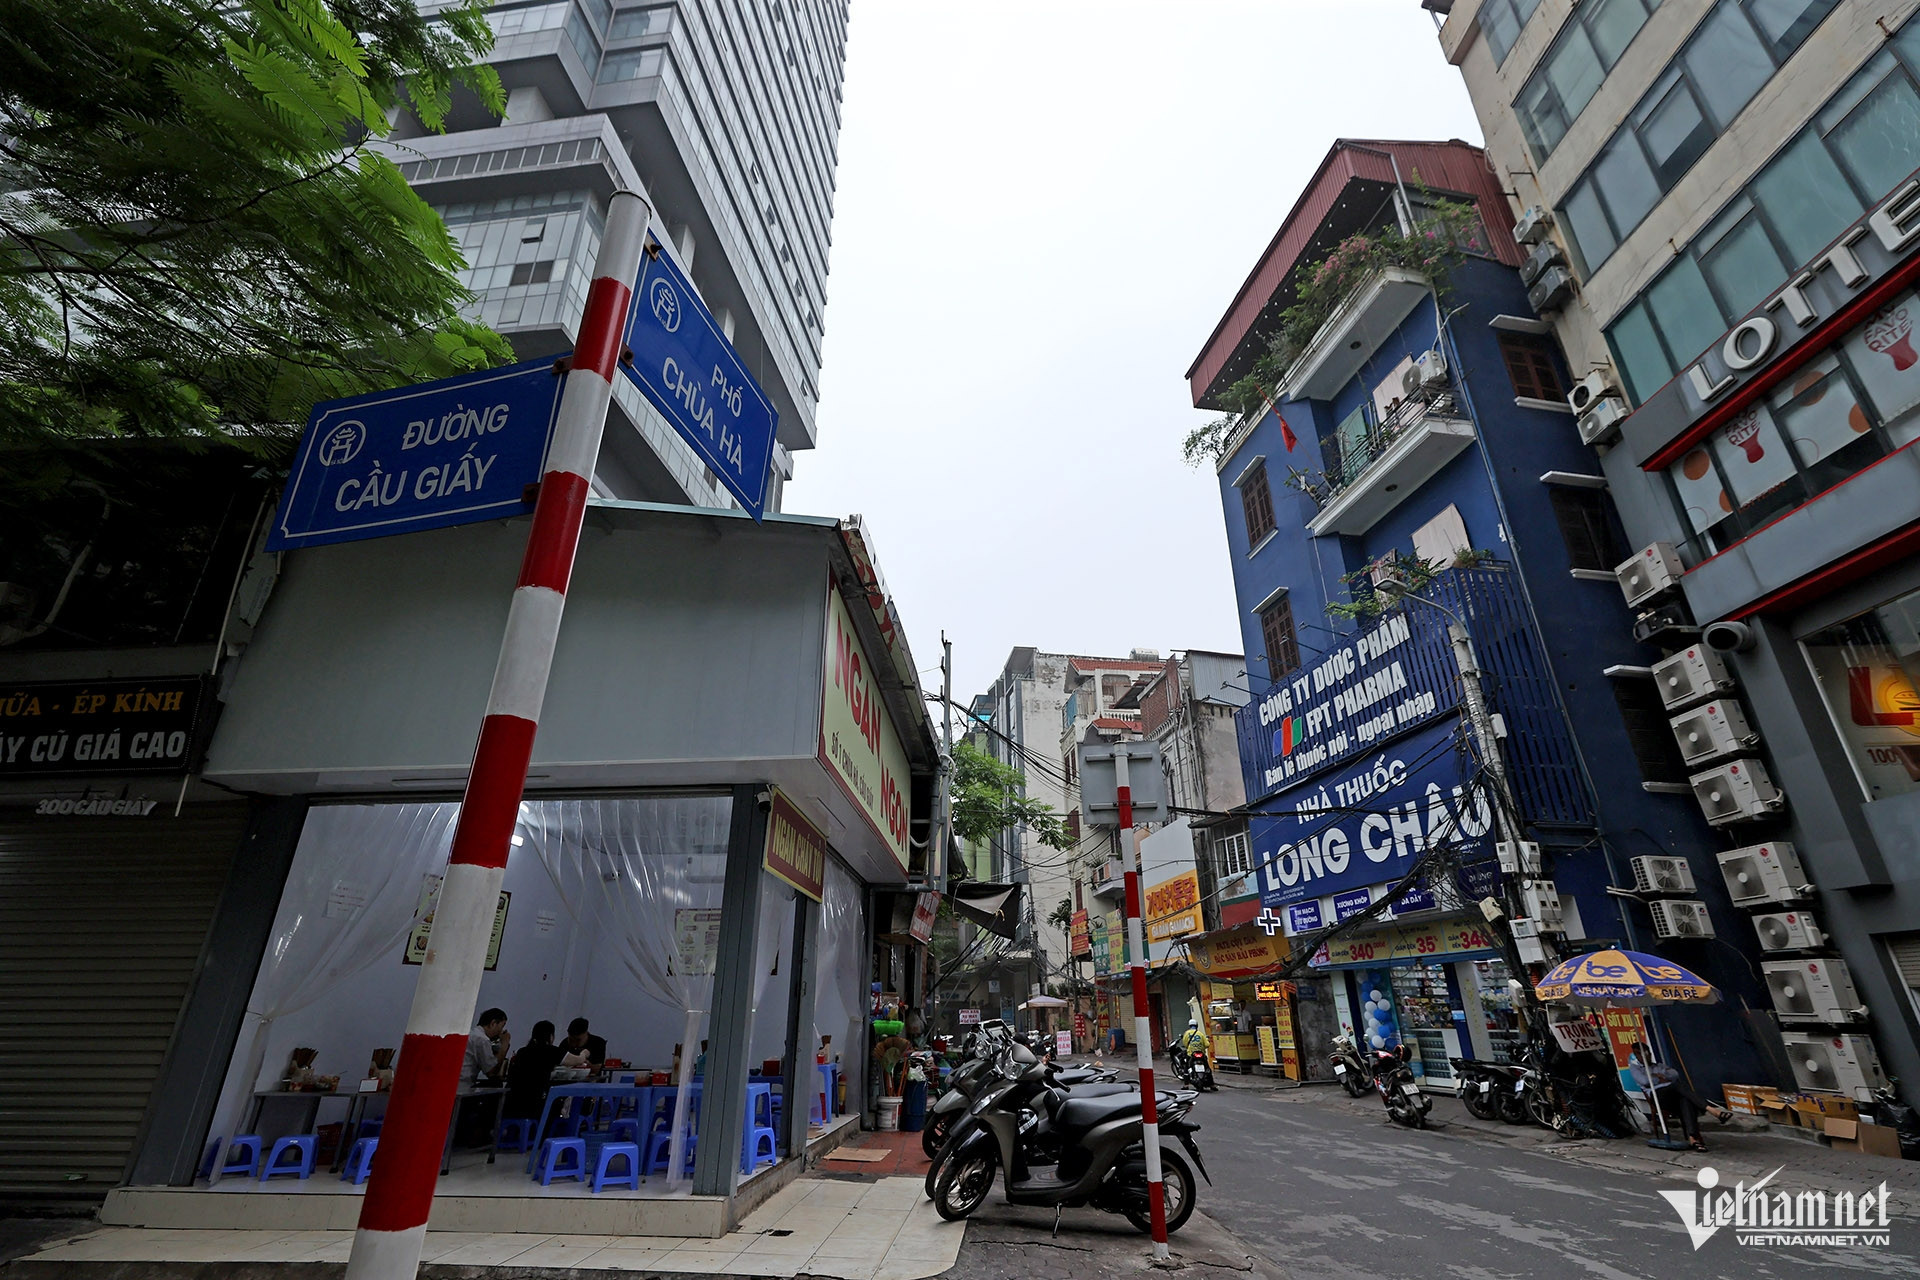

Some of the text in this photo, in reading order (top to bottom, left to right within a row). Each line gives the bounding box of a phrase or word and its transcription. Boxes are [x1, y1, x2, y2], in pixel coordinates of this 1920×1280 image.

[661, 355, 715, 441] CHÙA
[719, 423, 744, 476] HÀ
[710, 362, 743, 419] PHỐ
[402, 403, 510, 451] ĐƯỜNG
[335, 442, 498, 512] CẦU GIẤY
[1258, 613, 1411, 727] CÔNG TY DƯỢC PHẨM
[72, 689, 107, 715] ÉP
[112, 687, 185, 713] KÍNH
[1305, 660, 1408, 738] FPT PHARMA
[30, 728, 68, 763] CŨ
[74, 728, 121, 761] GIÁ
[129, 730, 187, 759] CAO
[834, 613, 882, 762] NGAN
[880, 760, 908, 853] NGON
[1265, 765, 1284, 788] Bán
[1295, 740, 1328, 772] thuốc
[1328, 731, 1349, 758] nội
[1356, 707, 1396, 746] ngoại
[1395, 690, 1436, 724] nhập
[35, 799, 74, 816] 300
[1296, 753, 1407, 824] NHÀ THUỐC
[772, 813, 796, 867] NGAN
[1263, 782, 1492, 892] LONG CHÂU
[1586, 961, 1627, 978] be
[1592, 984, 1614, 995] MÁY
[1632, 961, 1683, 980] be
[1661, 985, 1700, 999] GIÁ RẺ
[1571, 1039, 1590, 1050] XE
[1607, 1011, 1622, 1027] SỐT
